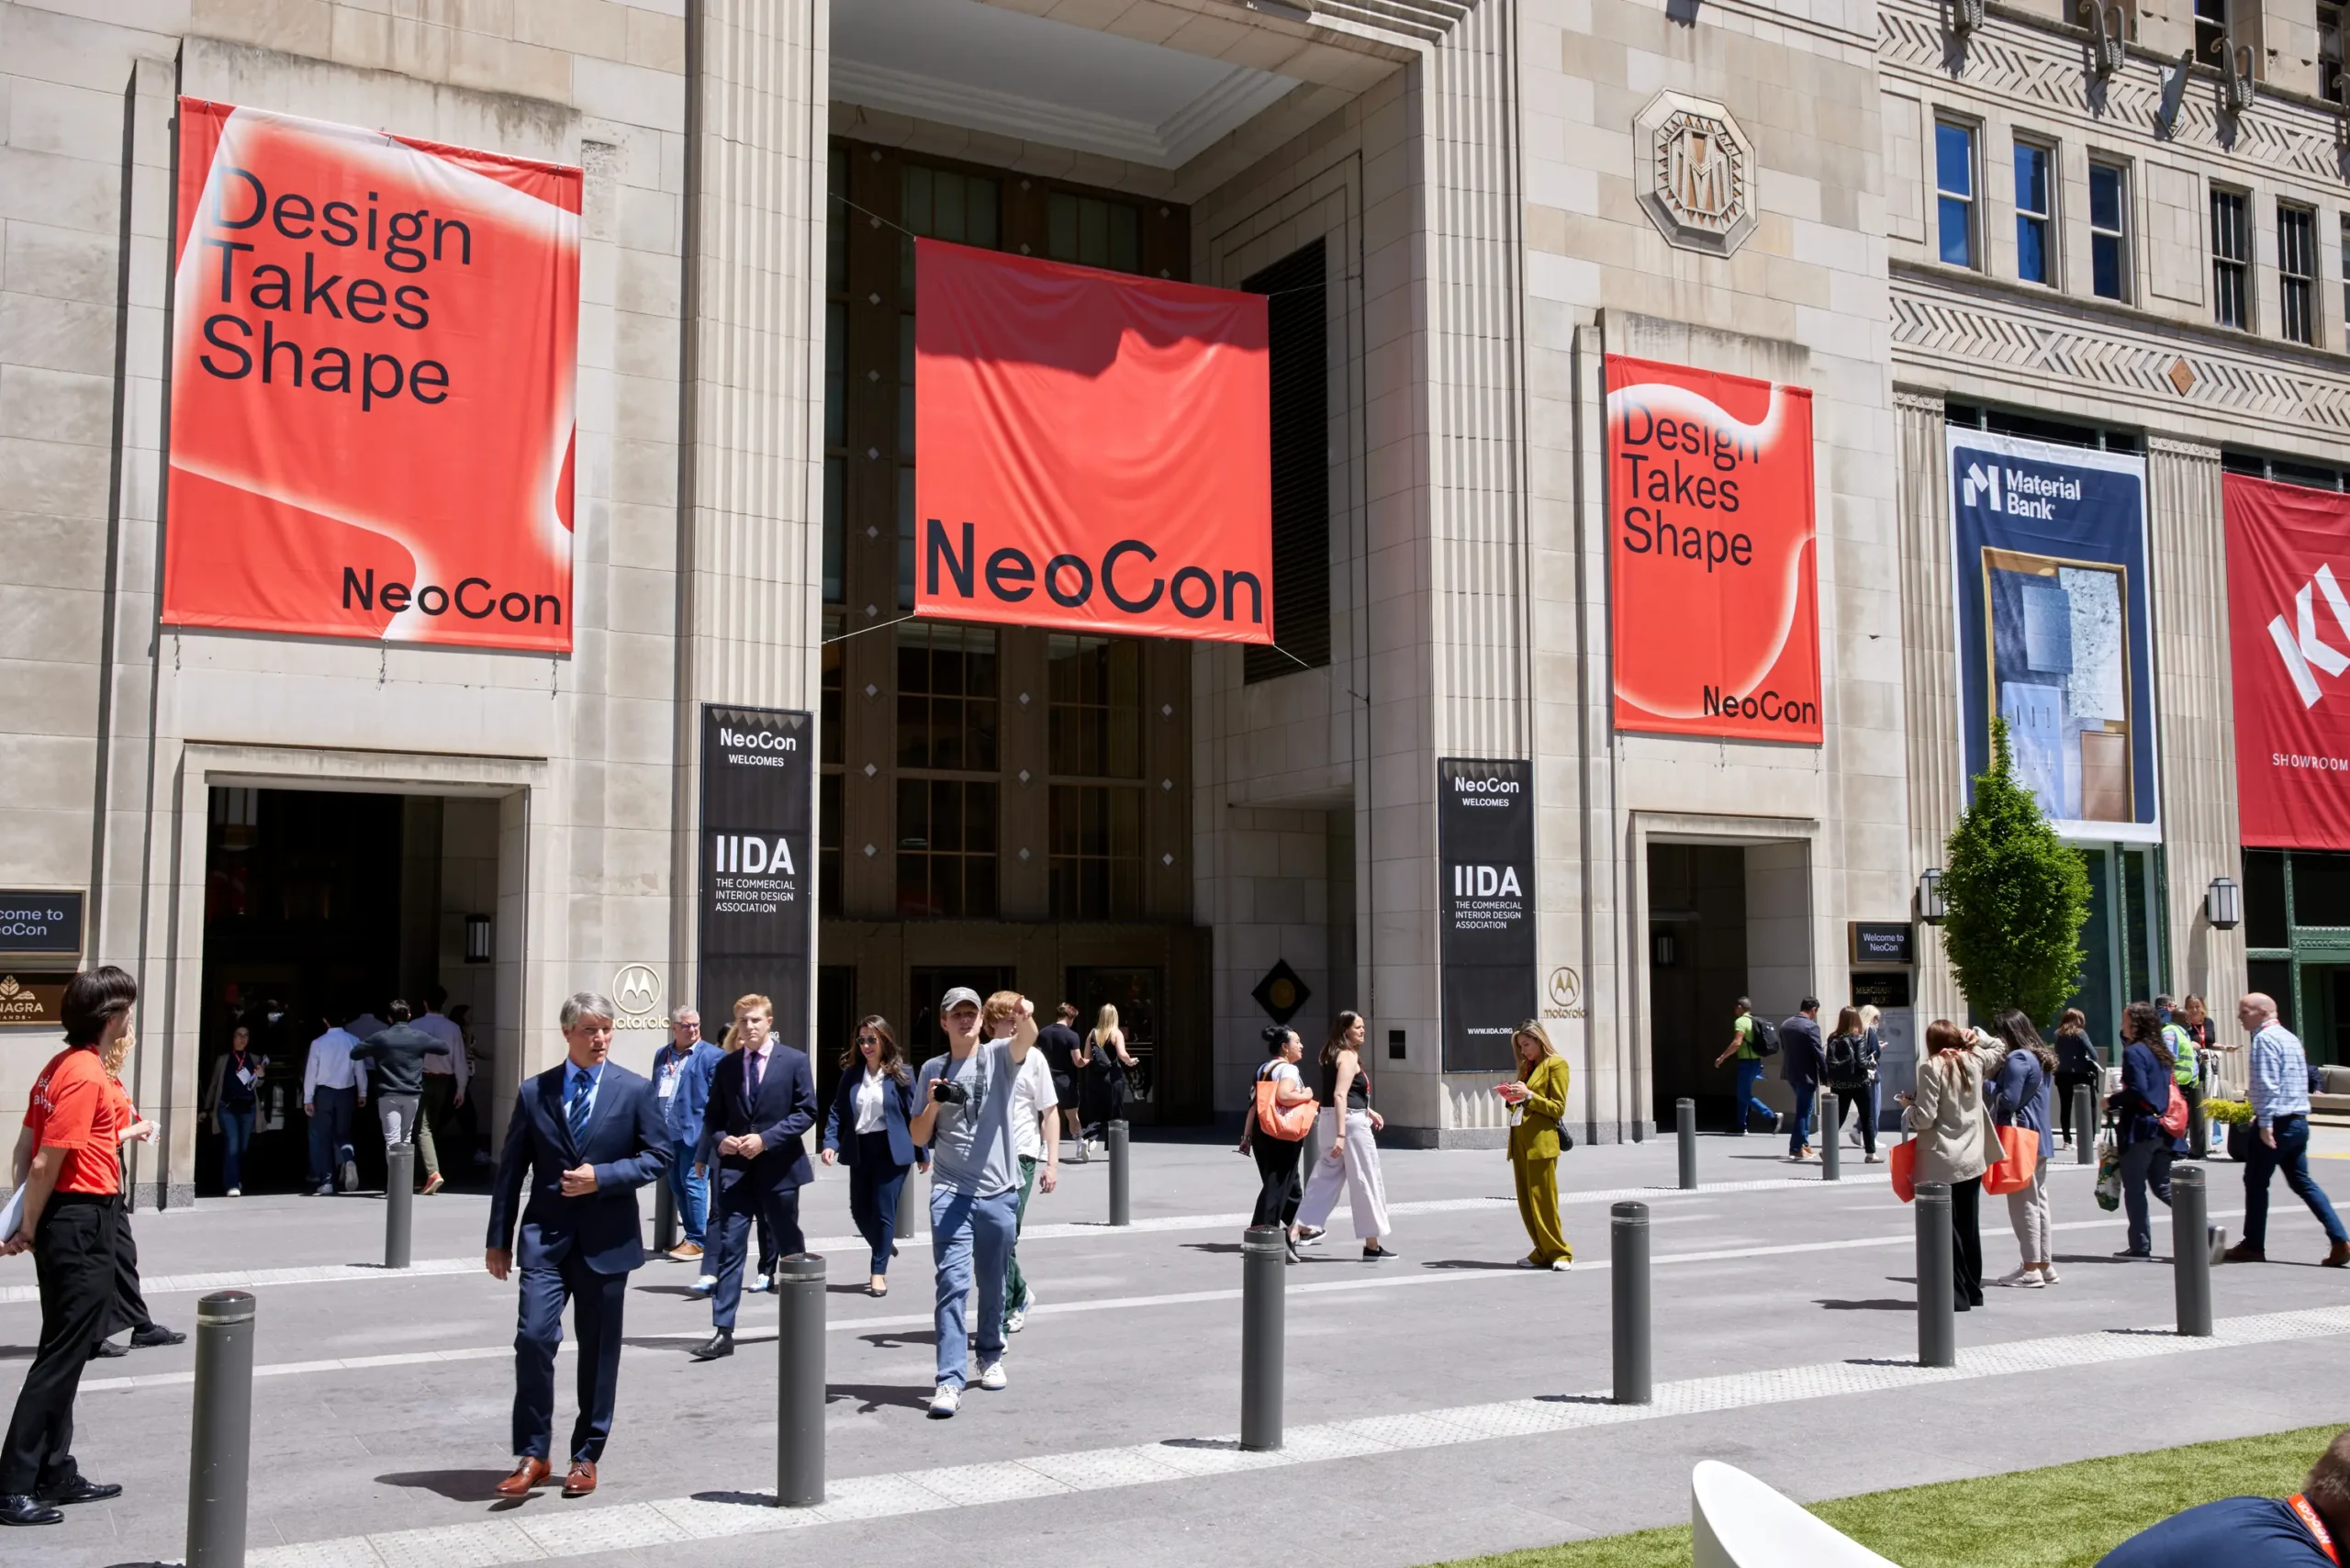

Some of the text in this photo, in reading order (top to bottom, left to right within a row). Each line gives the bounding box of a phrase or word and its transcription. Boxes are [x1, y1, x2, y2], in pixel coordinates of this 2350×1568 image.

[212, 165, 472, 274] Design
[202, 238, 430, 330] Takes
[199, 314, 450, 412] Shape
[1622, 400, 1759, 472] Design
[1620, 453, 1740, 512] Takes
[2006, 467, 2081, 500] Material
[2007, 492, 2053, 521] Bank
[1623, 506, 1752, 573] Shape
[925, 519, 1263, 624] NeoCon
[342, 566, 562, 626] NeoCon
[1703, 685, 1816, 724] NeoCon
[720, 727, 796, 752] NeoCon
[728, 754, 784, 767] WELCOMES
[2272, 753, 2349, 771] SHOWROOM
[1455, 777, 1519, 793] NeoCon
[1462, 798, 1509, 807] WELCOMES
[716, 834, 795, 875] IIDA
[716, 878, 795, 890] THE COMMERCIAL
[1455, 866, 1522, 897] IIDA
[715, 890, 794, 902] INTERIOR DESIGN
[1455, 901, 1522, 910] THE COMMERCIAL
[46, 908, 63, 921] to
[715, 902, 777, 913] ASSOCIATION
[1455, 911, 1522, 919] INTERIOR DESIGN
[0, 923, 47, 935] oCon
[1455, 921, 1507, 929] ASSOCIATION
[1863, 933, 1904, 942] Welcome to
[1869, 943, 1898, 951] NeoCon
[612, 1014, 671, 1030] otorola
[2297, 1501, 2332, 1543] NeoCon
